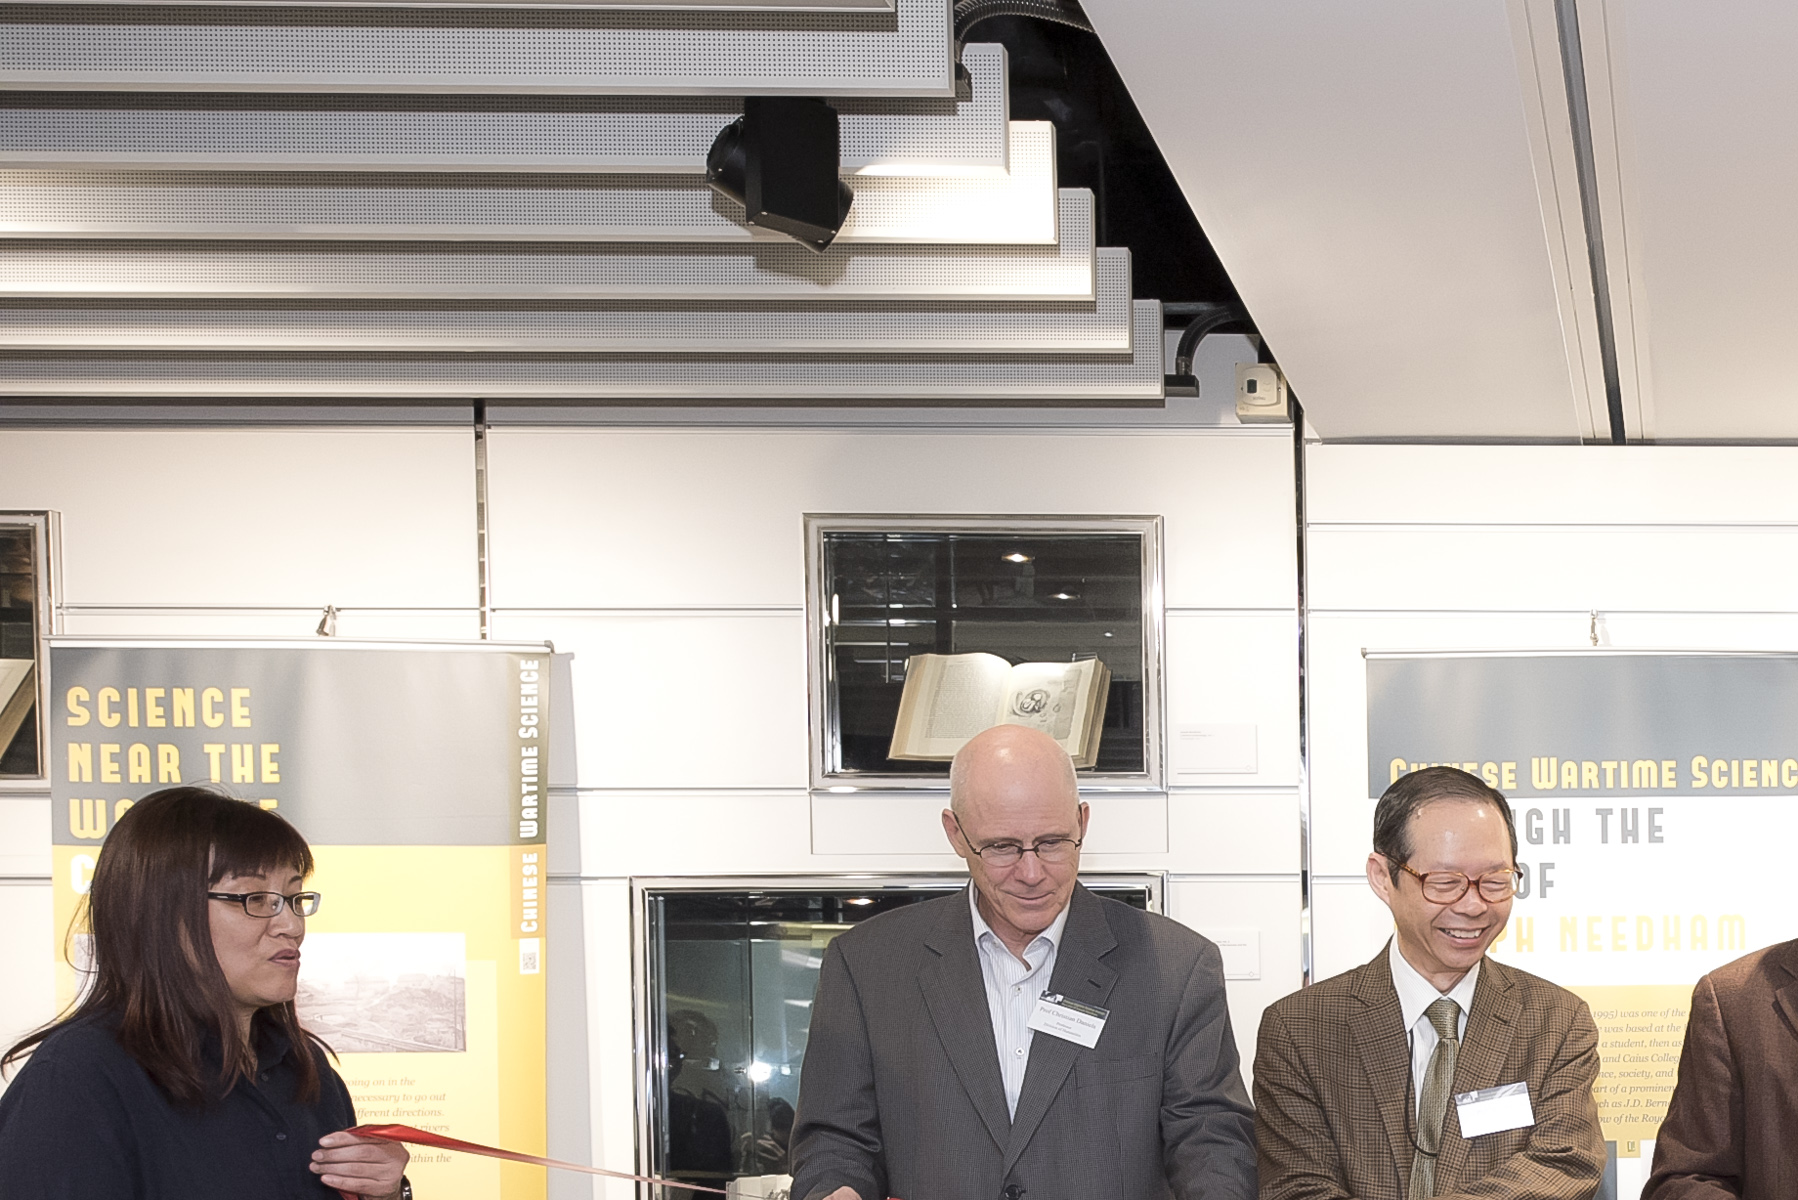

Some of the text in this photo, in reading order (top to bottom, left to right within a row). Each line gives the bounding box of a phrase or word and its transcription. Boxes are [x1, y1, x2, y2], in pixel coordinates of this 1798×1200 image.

[66, 686, 252, 728] SCIENCE
[68, 743, 281, 784] NEAR THE
[1530, 756, 1677, 790] WARTIME
[1691, 755, 1798, 789] SCIENC
[518, 658, 539, 934] CHINESE WARTIME SCIENCE
[1595, 807, 1665, 844] THE
[1514, 862, 1556, 900] OF
[1560, 913, 1747, 952] NEEDHAM
[1604, 1025, 1623, 1033] was
[1625, 1023, 1652, 1033] based
[1667, 1023, 1681, 1032] the
[1610, 1038, 1669, 1048] student, then
[1602, 1053, 1649, 1063] and Caius
[1618, 1068, 1674, 1079] society, and
